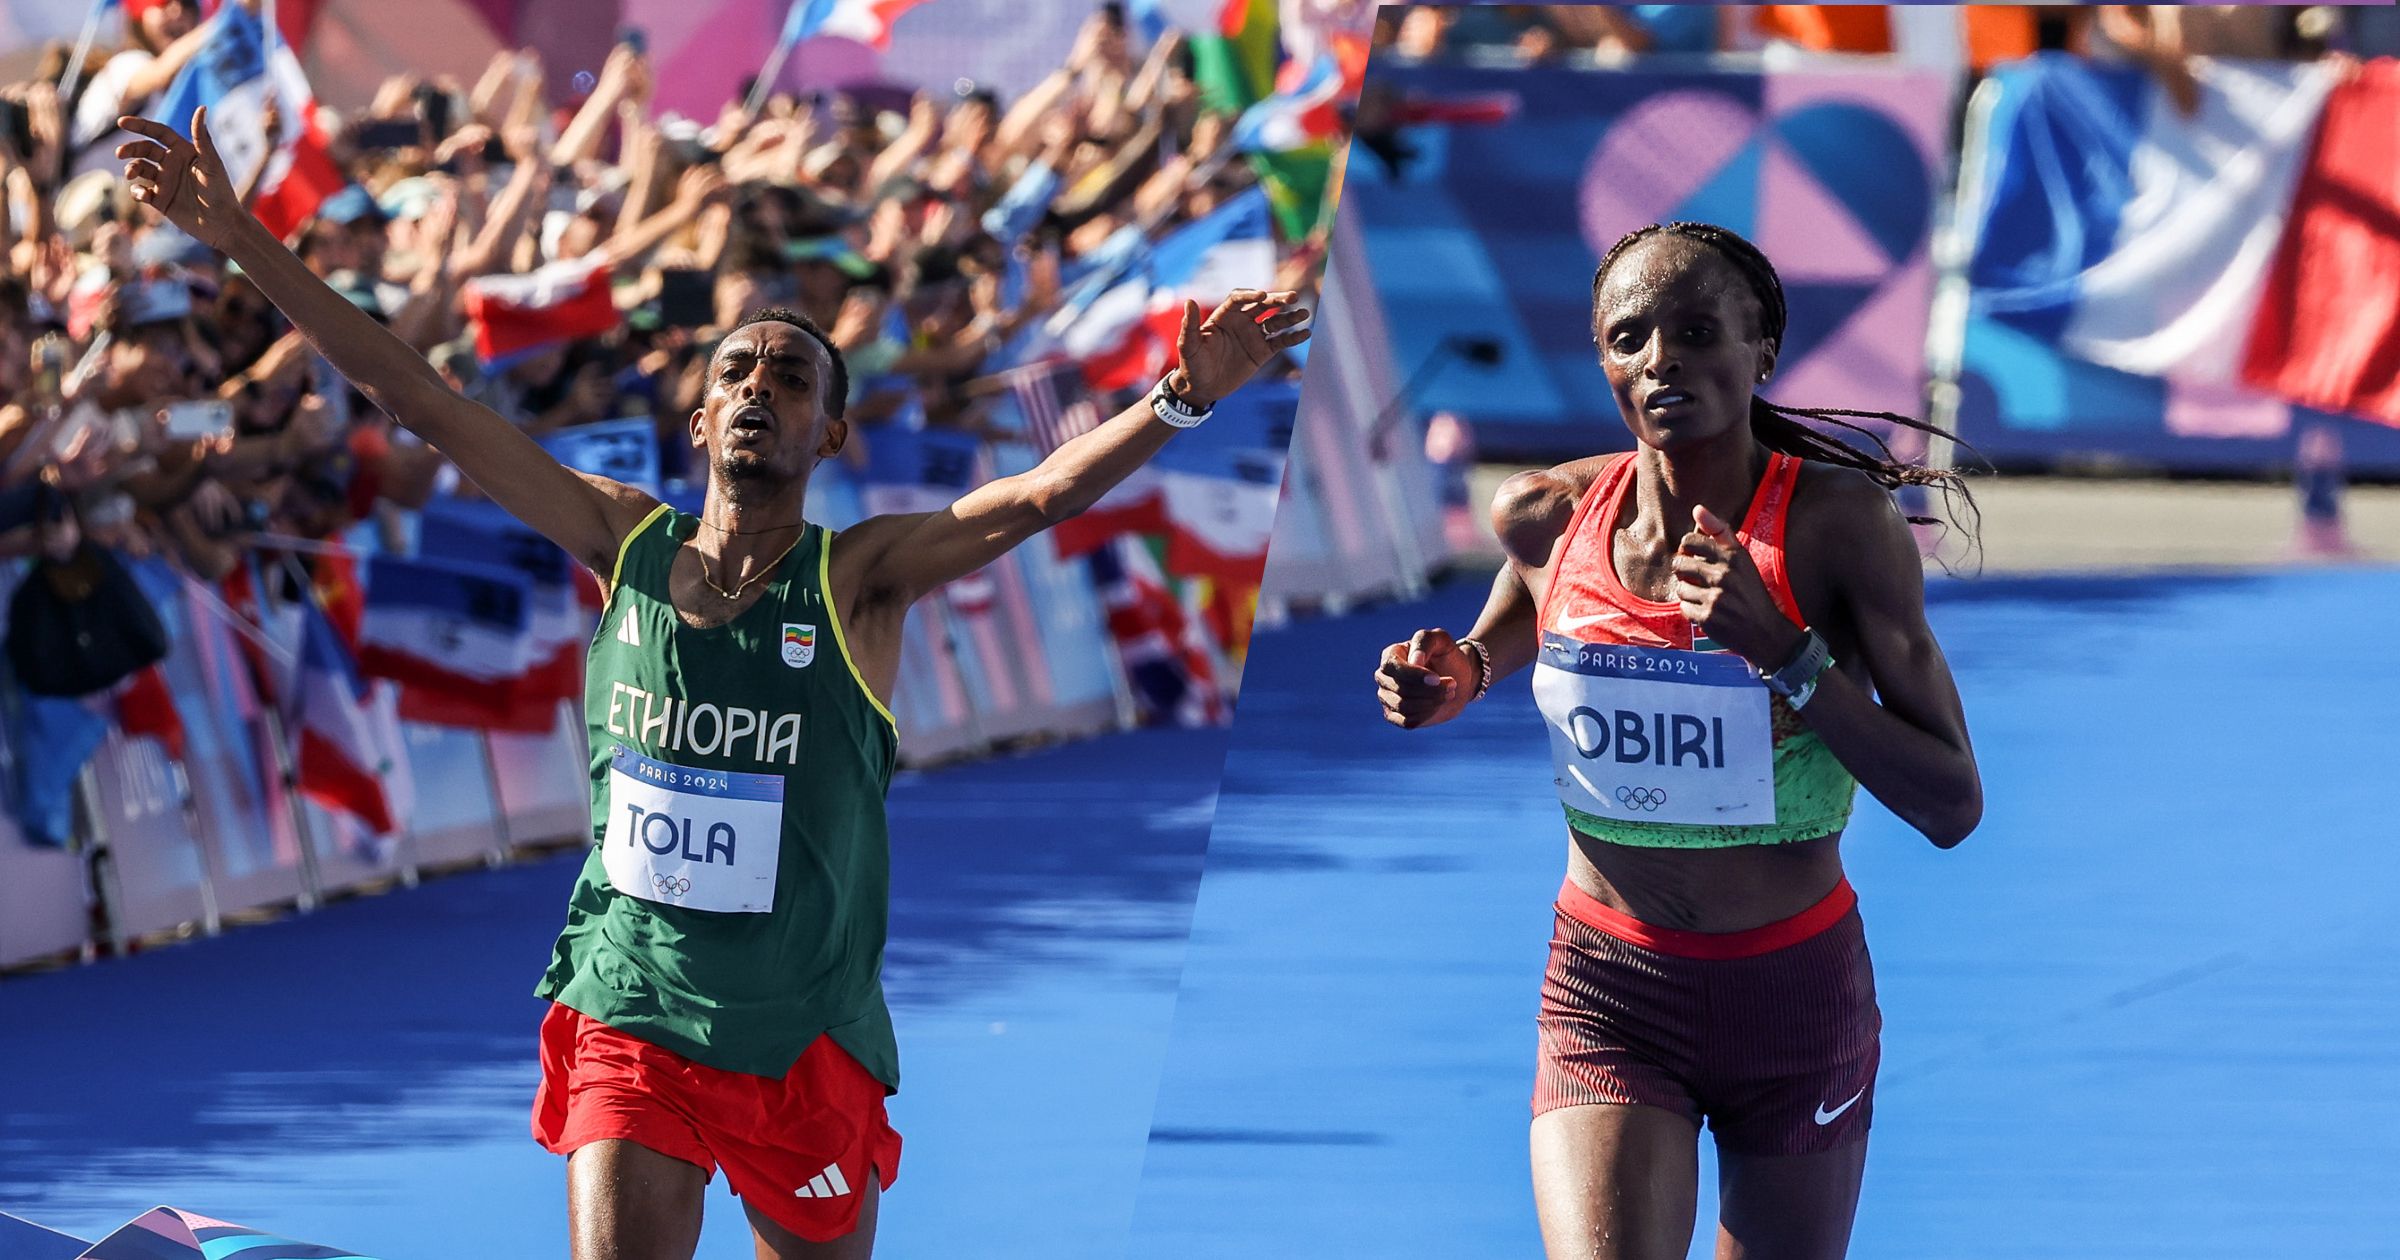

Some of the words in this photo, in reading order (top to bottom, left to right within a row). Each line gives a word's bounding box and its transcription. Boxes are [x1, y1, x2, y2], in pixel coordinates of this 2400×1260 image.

[1580, 651, 1637, 670] PARIS
[1646, 658, 1699, 675] 2024
[608, 681, 802, 765] ETHIOPIA
[1567, 706, 1725, 769] OBIRI
[639, 762, 677, 784] PARIS
[683, 776, 728, 791] 2024
[627, 803, 736, 866] TOLA
